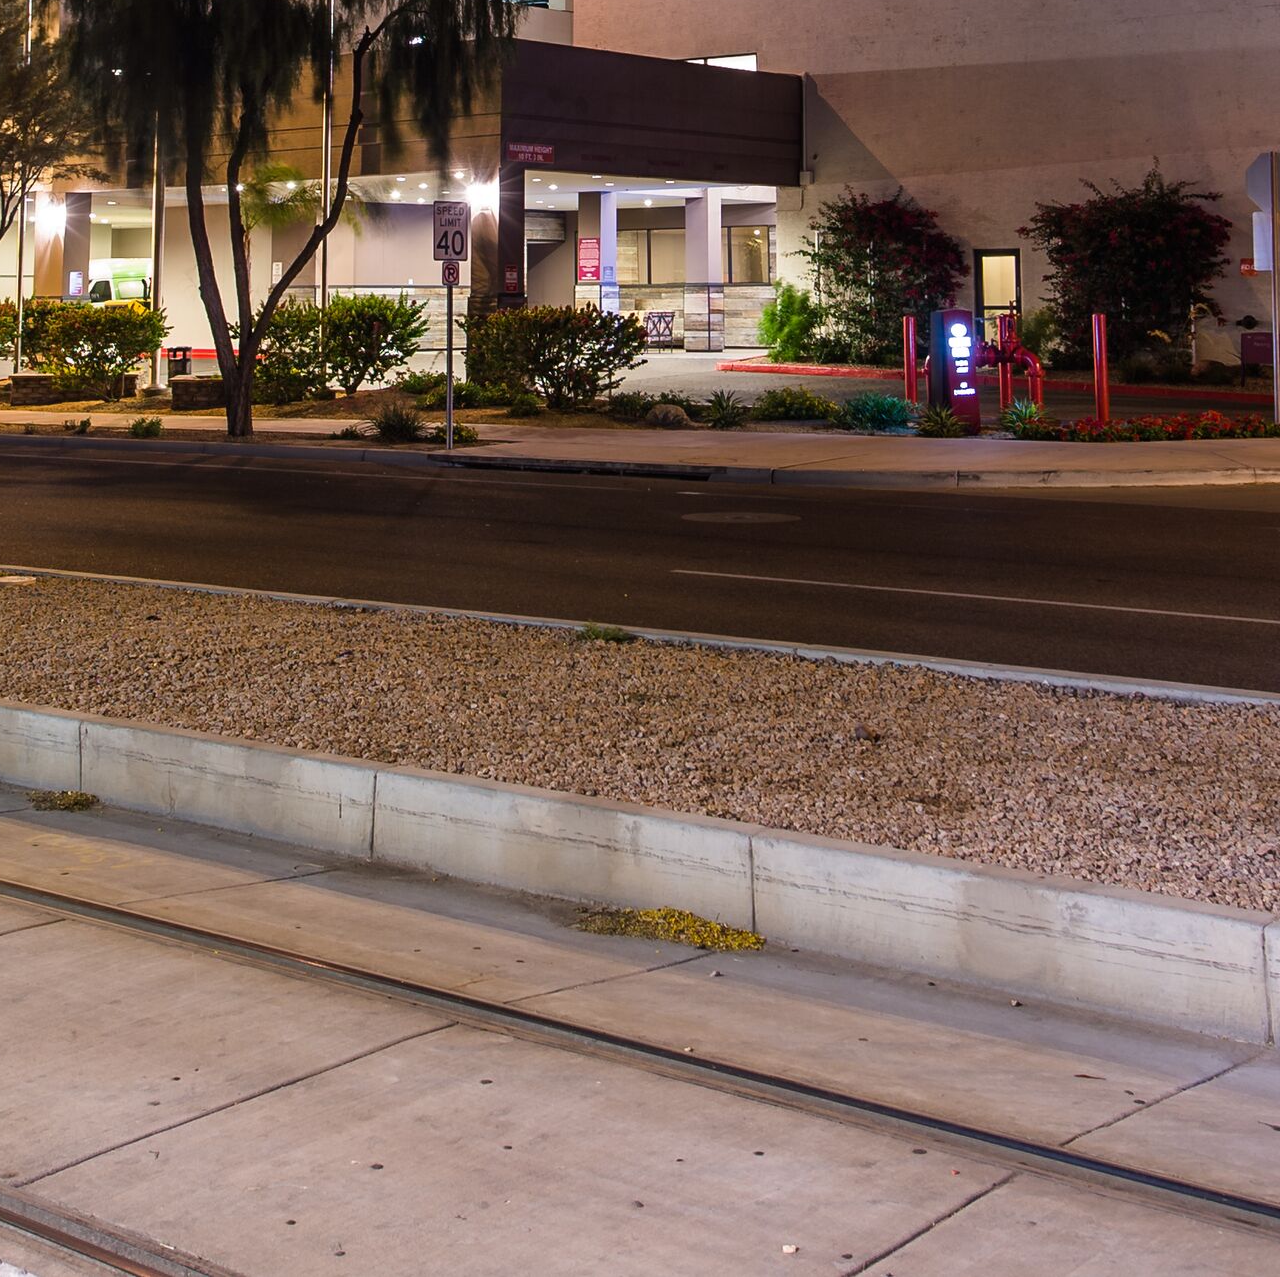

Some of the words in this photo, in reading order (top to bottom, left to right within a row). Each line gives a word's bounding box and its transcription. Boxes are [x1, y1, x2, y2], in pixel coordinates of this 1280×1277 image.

[509, 144, 534, 152] MAXIMUM
[534, 145, 553, 154] HEIGHT
[436, 206, 465, 216] SPEED
[439, 217, 462, 227] LIMIT
[436, 230, 465, 256] 40
